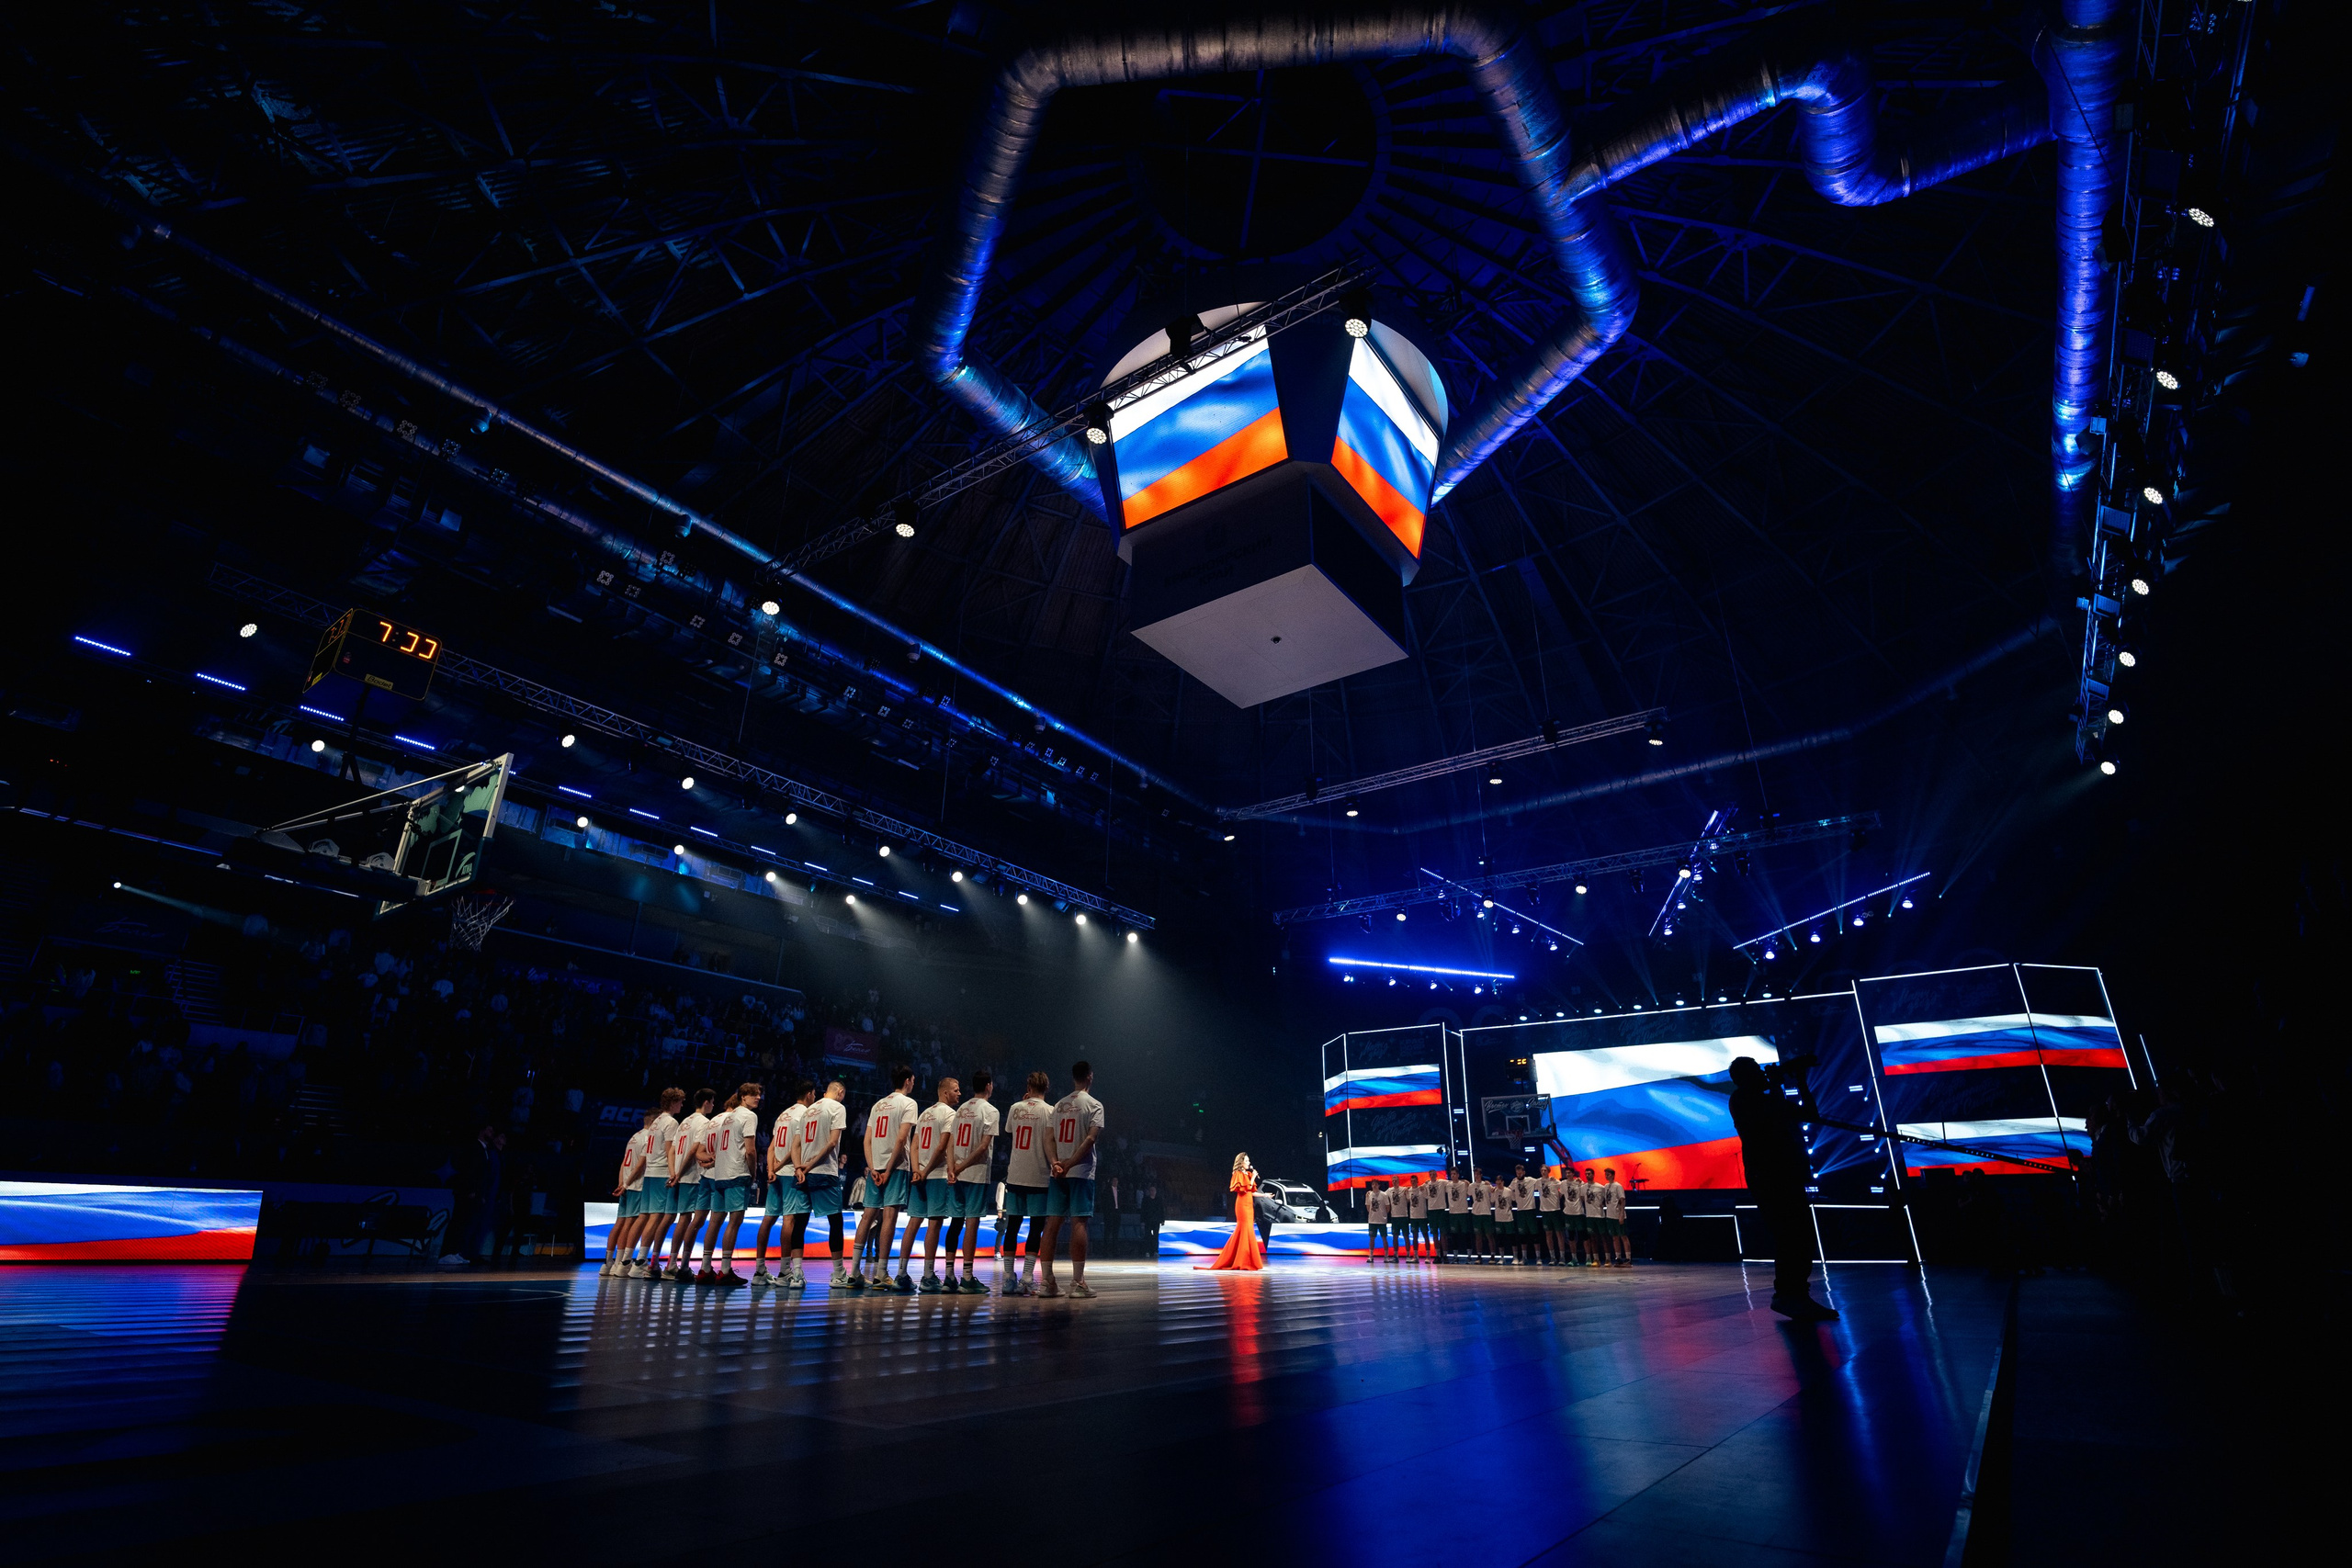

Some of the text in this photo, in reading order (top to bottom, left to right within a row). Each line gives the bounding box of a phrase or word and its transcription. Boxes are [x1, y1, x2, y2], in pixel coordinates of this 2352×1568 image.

[1164, 535, 1272, 588] КРАСНОЯРСКИЙ
[1198, 565, 1234, 586] КРАЙ
[367, 676, 392, 689] Bodet
[775, 1126, 787, 1147] 10
[875, 1115, 888, 1138] 10
[921, 1126, 932, 1149] 10
[956, 1122, 972, 1146] 10
[1015, 1125, 1033, 1150] 10
[1058, 1118, 1076, 1143] 10
